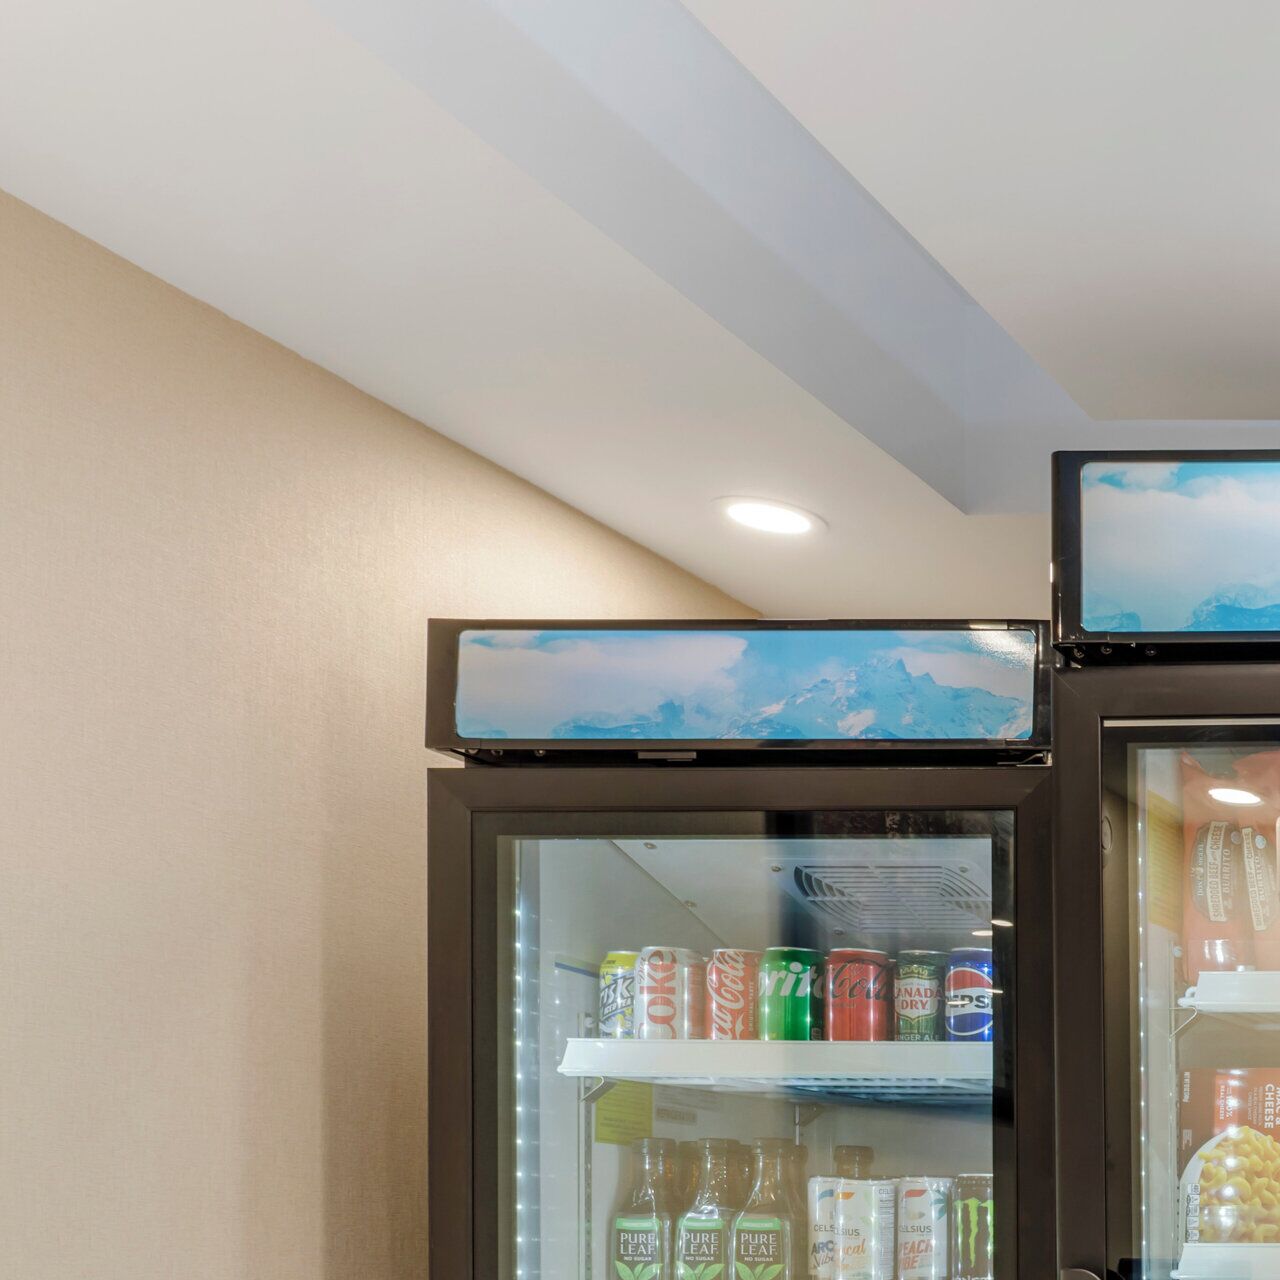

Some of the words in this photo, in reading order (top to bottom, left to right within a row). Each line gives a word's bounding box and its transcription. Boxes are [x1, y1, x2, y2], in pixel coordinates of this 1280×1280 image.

[901, 999, 928, 1010] DRY
[1264, 1084, 1274, 1129] CHEESE
[621, 1233, 656, 1244] PURE
[682, 1233, 718, 1244] PURE
[741, 1233, 777, 1244] PURE
[621, 1244, 656, 1255] LEAF
[741, 1244, 777, 1255] LEAF
